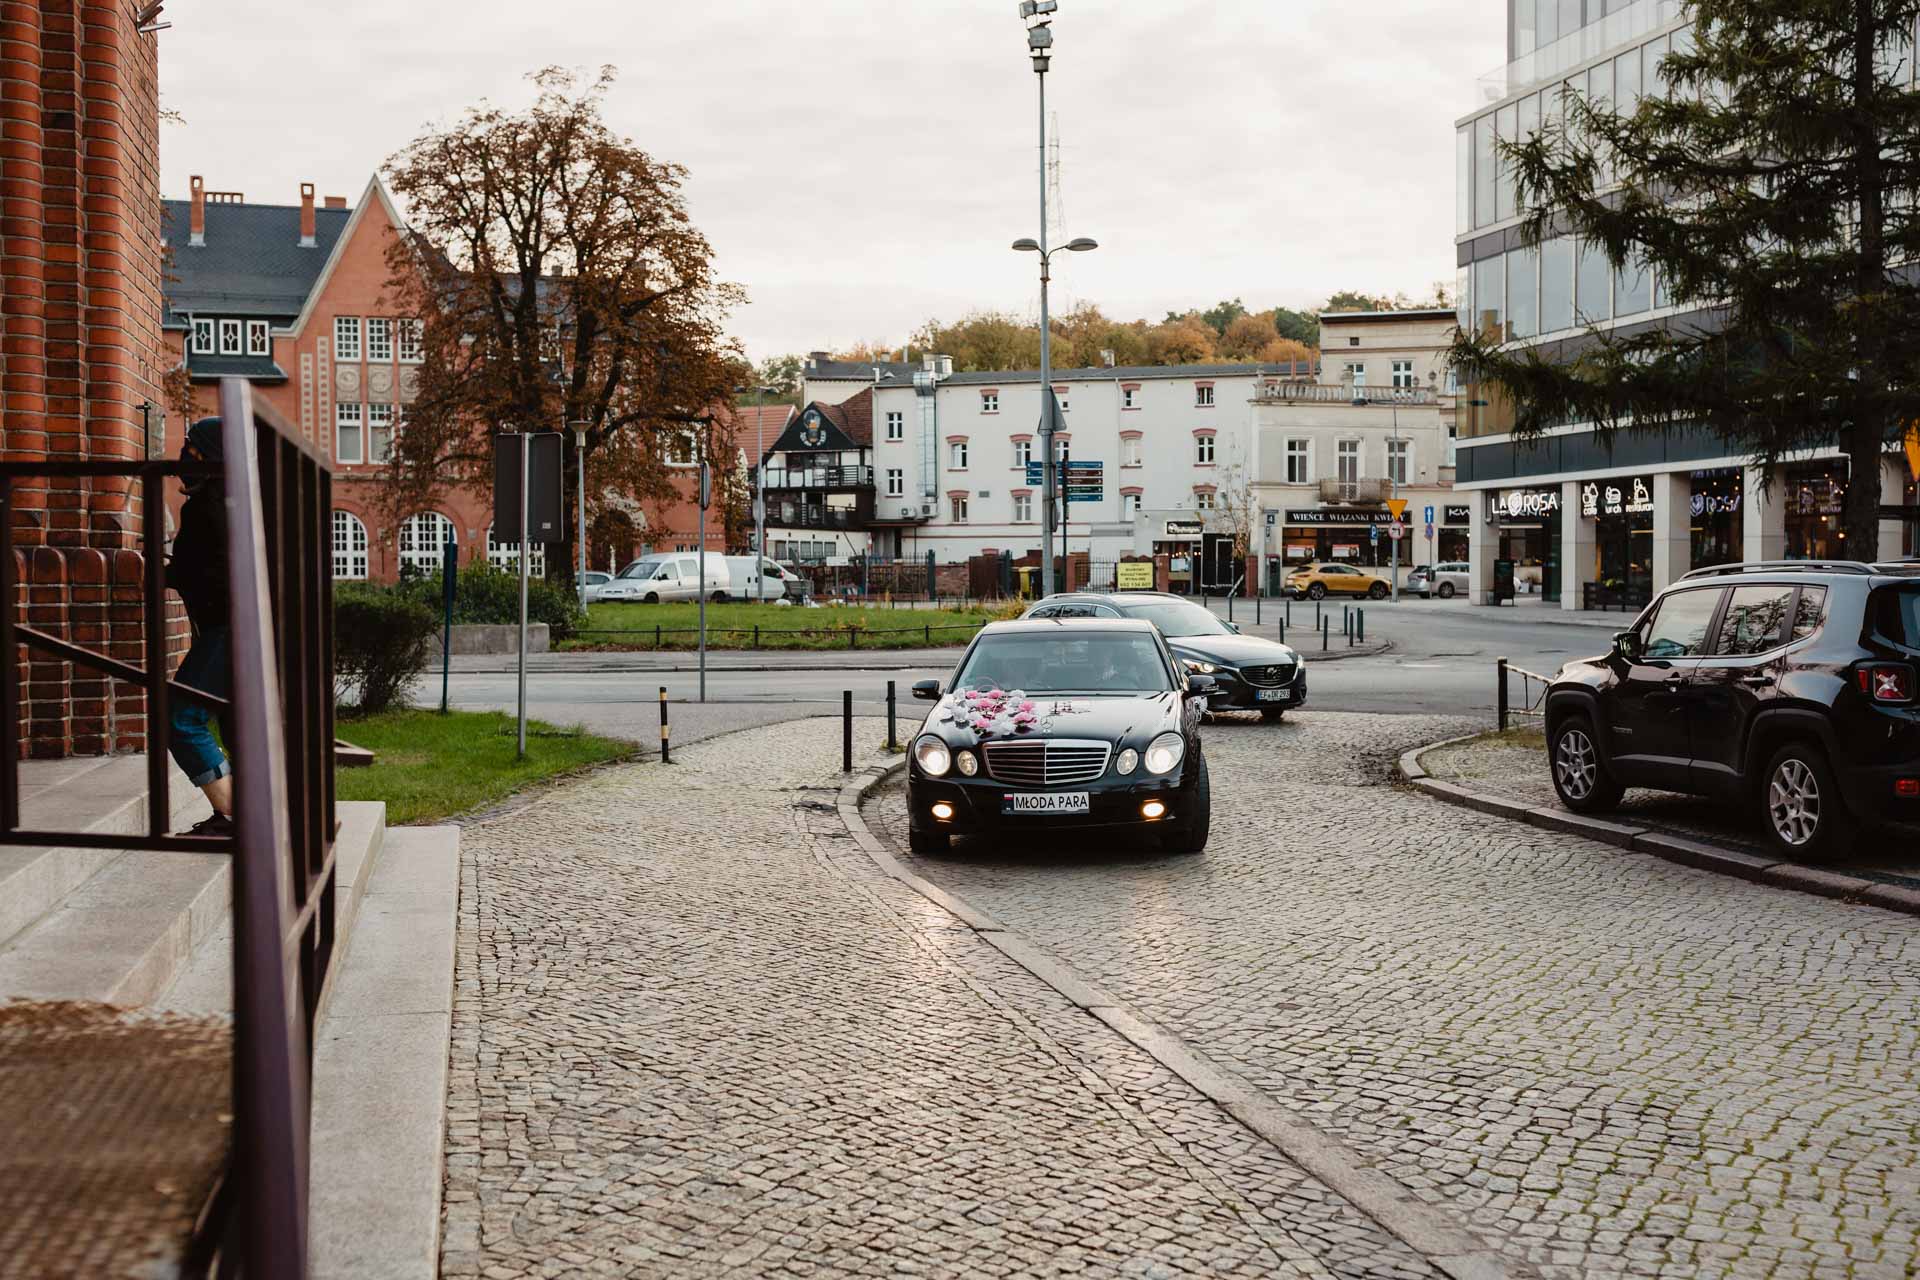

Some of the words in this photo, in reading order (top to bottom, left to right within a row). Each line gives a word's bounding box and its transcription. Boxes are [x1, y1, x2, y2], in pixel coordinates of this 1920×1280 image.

[1491, 497, 1507, 514] LA
[1523, 492, 1558, 512] ROSA
[1625, 502, 1654, 513] restauran
[1292, 511, 1325, 521] WIEŃCE
[1329, 512, 1369, 523] WIĄZANKI
[1374, 512, 1406, 522] KWIAY
[1015, 796, 1056, 809] MŁODA
[1058, 795, 1088, 808] PARA
